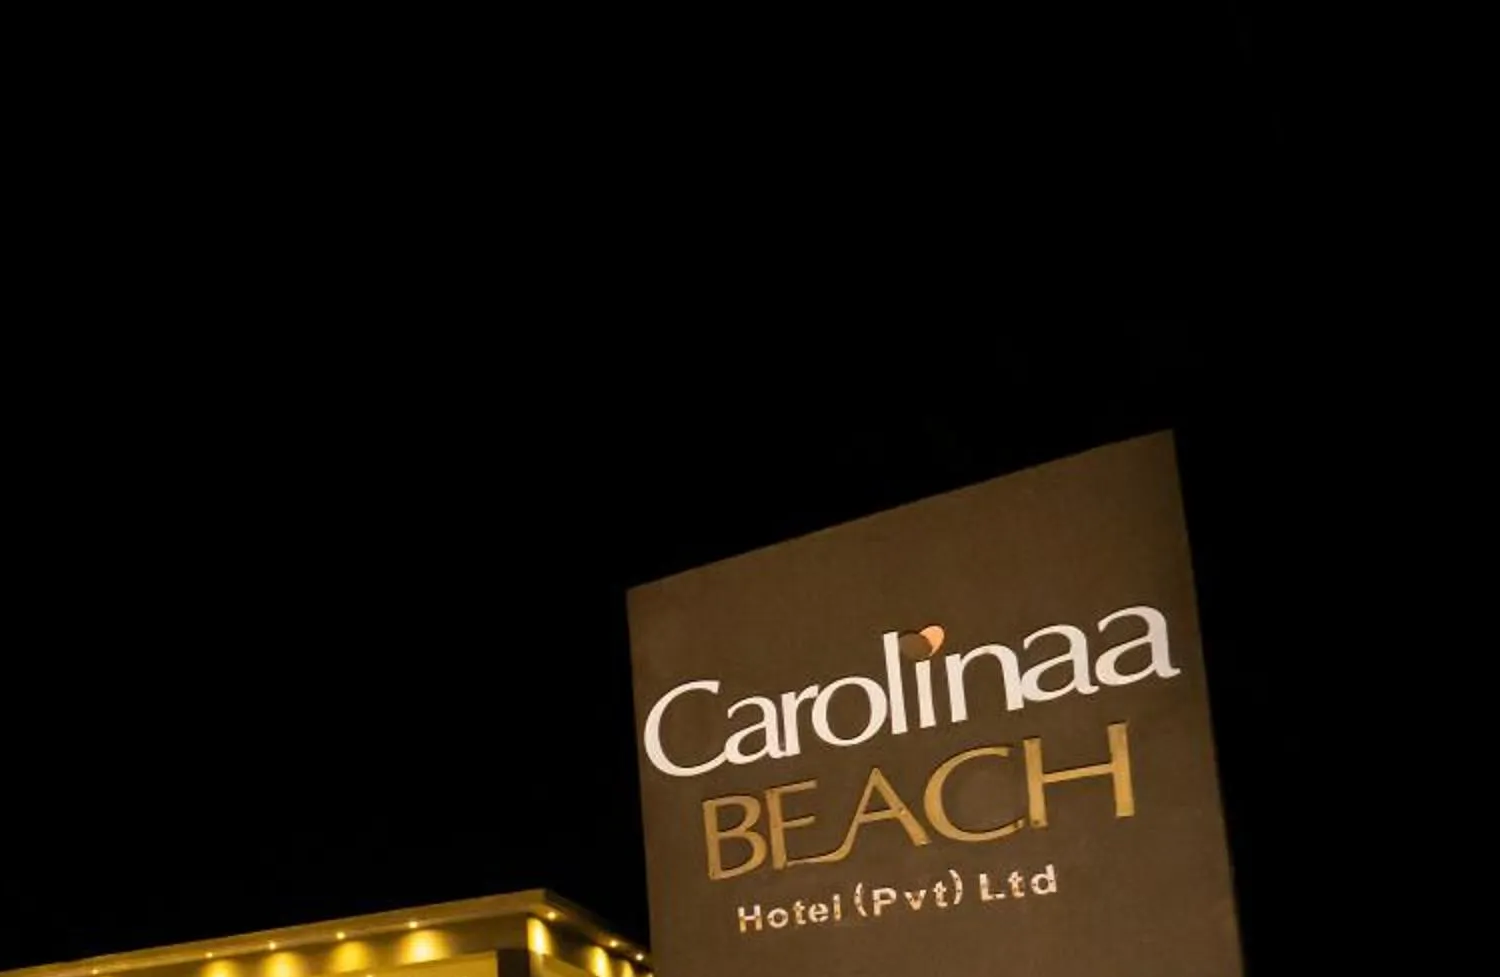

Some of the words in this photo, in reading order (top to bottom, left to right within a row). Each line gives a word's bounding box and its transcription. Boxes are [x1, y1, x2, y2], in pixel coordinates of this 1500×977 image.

[643, 605, 1181, 777] Carolinaa
[703, 721, 1135, 881] BEACH
[738, 893, 842, 933] Hotel
[854, 869, 963, 918] (Pvt)
[979, 863, 1058, 902] Ltd
